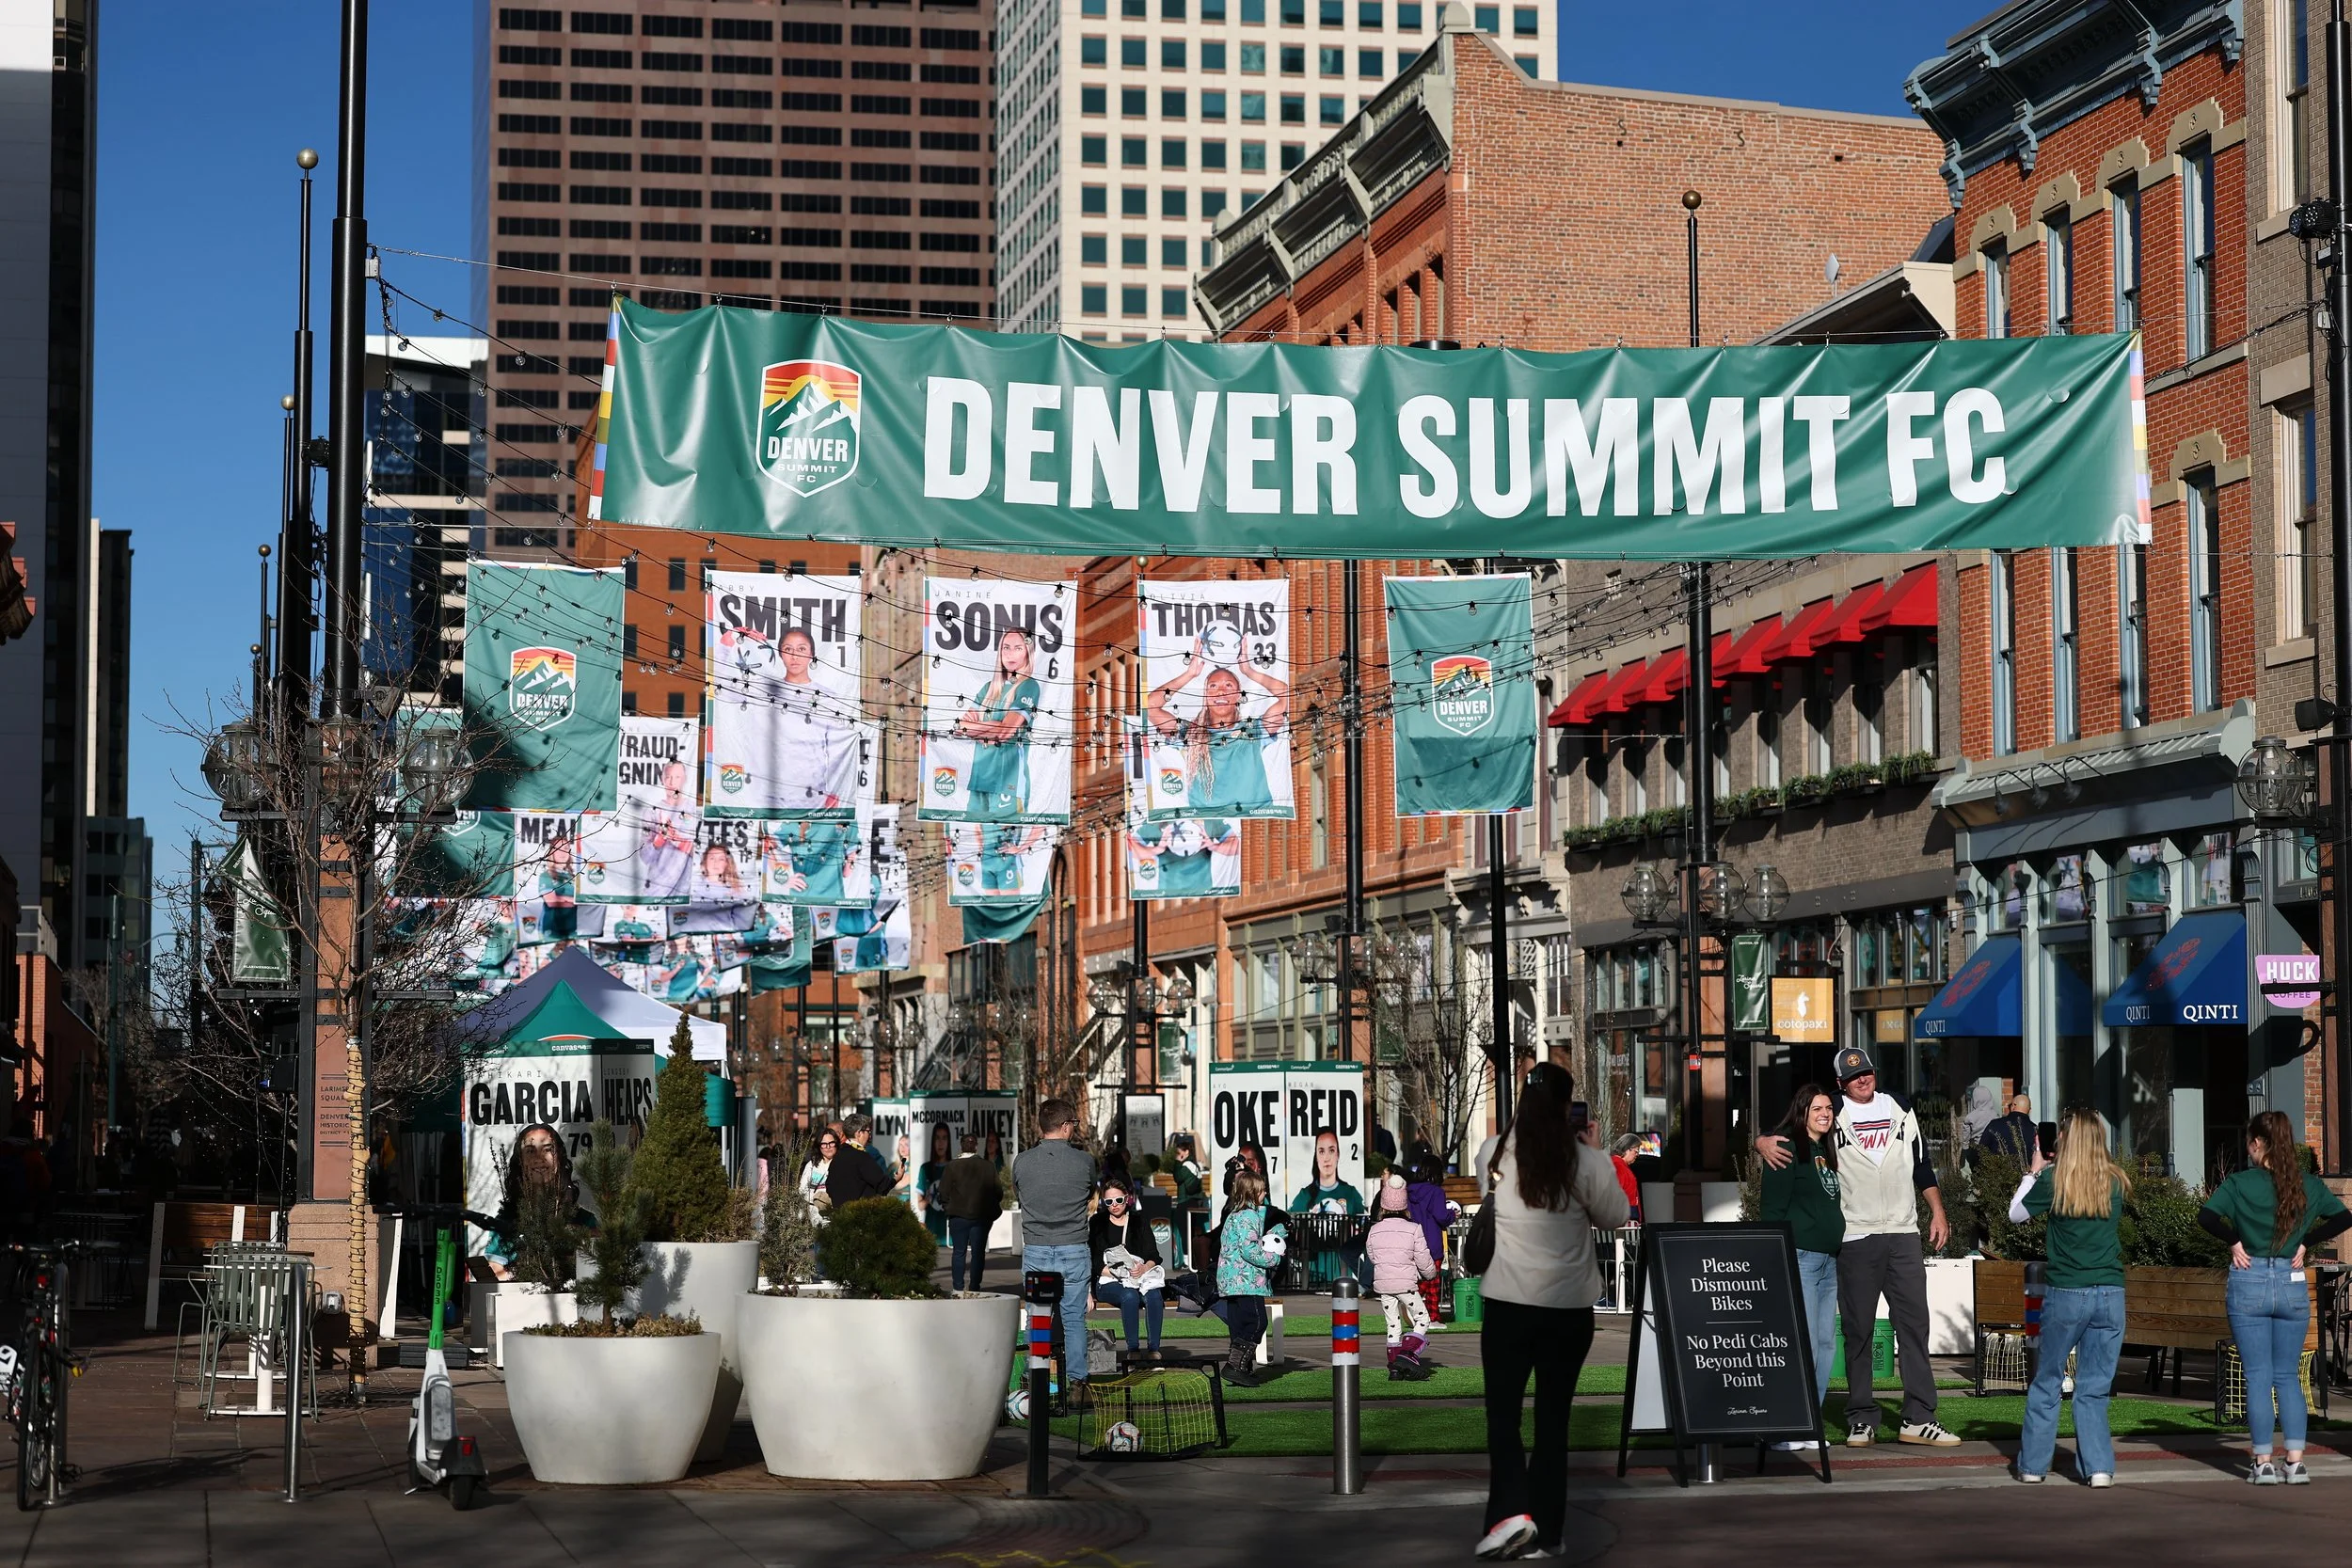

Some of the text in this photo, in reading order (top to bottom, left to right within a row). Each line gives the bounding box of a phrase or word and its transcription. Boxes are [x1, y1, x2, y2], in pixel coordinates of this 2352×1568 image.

[767, 436, 849, 462] DENVER
[923, 374, 2008, 519] DENVER SUMMIT FC
[777, 463, 838, 473] SUMMIT
[796, 474, 817, 483] FC
[934, 590, 992, 599] JANINE
[718, 594, 847, 643] SMITH
[934, 600, 1063, 654] SONIS
[1151, 601, 1277, 637] THOMAS
[836, 645, 846, 668] 1
[1253, 641, 1277, 666] 33
[1047, 657, 1059, 680] 6
[516, 692, 568, 710] DENVER
[1439, 700, 1488, 715] DENVER
[2266, 961, 2317, 981] HUCK
[2273, 990, 2312, 999] COFFEE
[2125, 1005, 2150, 1022] QINTI
[2183, 1004, 2239, 1022] QINTI
[1776, 1019, 1828, 1031] cotopaxi
[1925, 1020, 1946, 1035] QINTI
[470, 1081, 594, 1126] GARCIA
[604, 1077, 653, 1126] HEAPS
[912, 1109, 965, 1124] MCCORMACK
[1214, 1090, 1280, 1149] OKE
[1289, 1088, 1359, 1137] REID
[970, 1109, 1015, 1139] AIKEY
[567, 1132, 593, 1158] 79
[1006, 1141, 1014, 1155] 12
[1351, 1143, 1359, 1161] 2
[1270, 1156, 1279, 1174] 7
[1701, 1258, 1751, 1274] Please
[435, 1266, 443, 1305] D5033
[1691, 1276, 1769, 1292] Dismount
[1710, 1295, 1753, 1311] Bikes
[1686, 1332, 1788, 1350] No Pedi Cabs
[1694, 1352, 1786, 1371] Beyond this
[1723, 1371, 1765, 1387] Point
